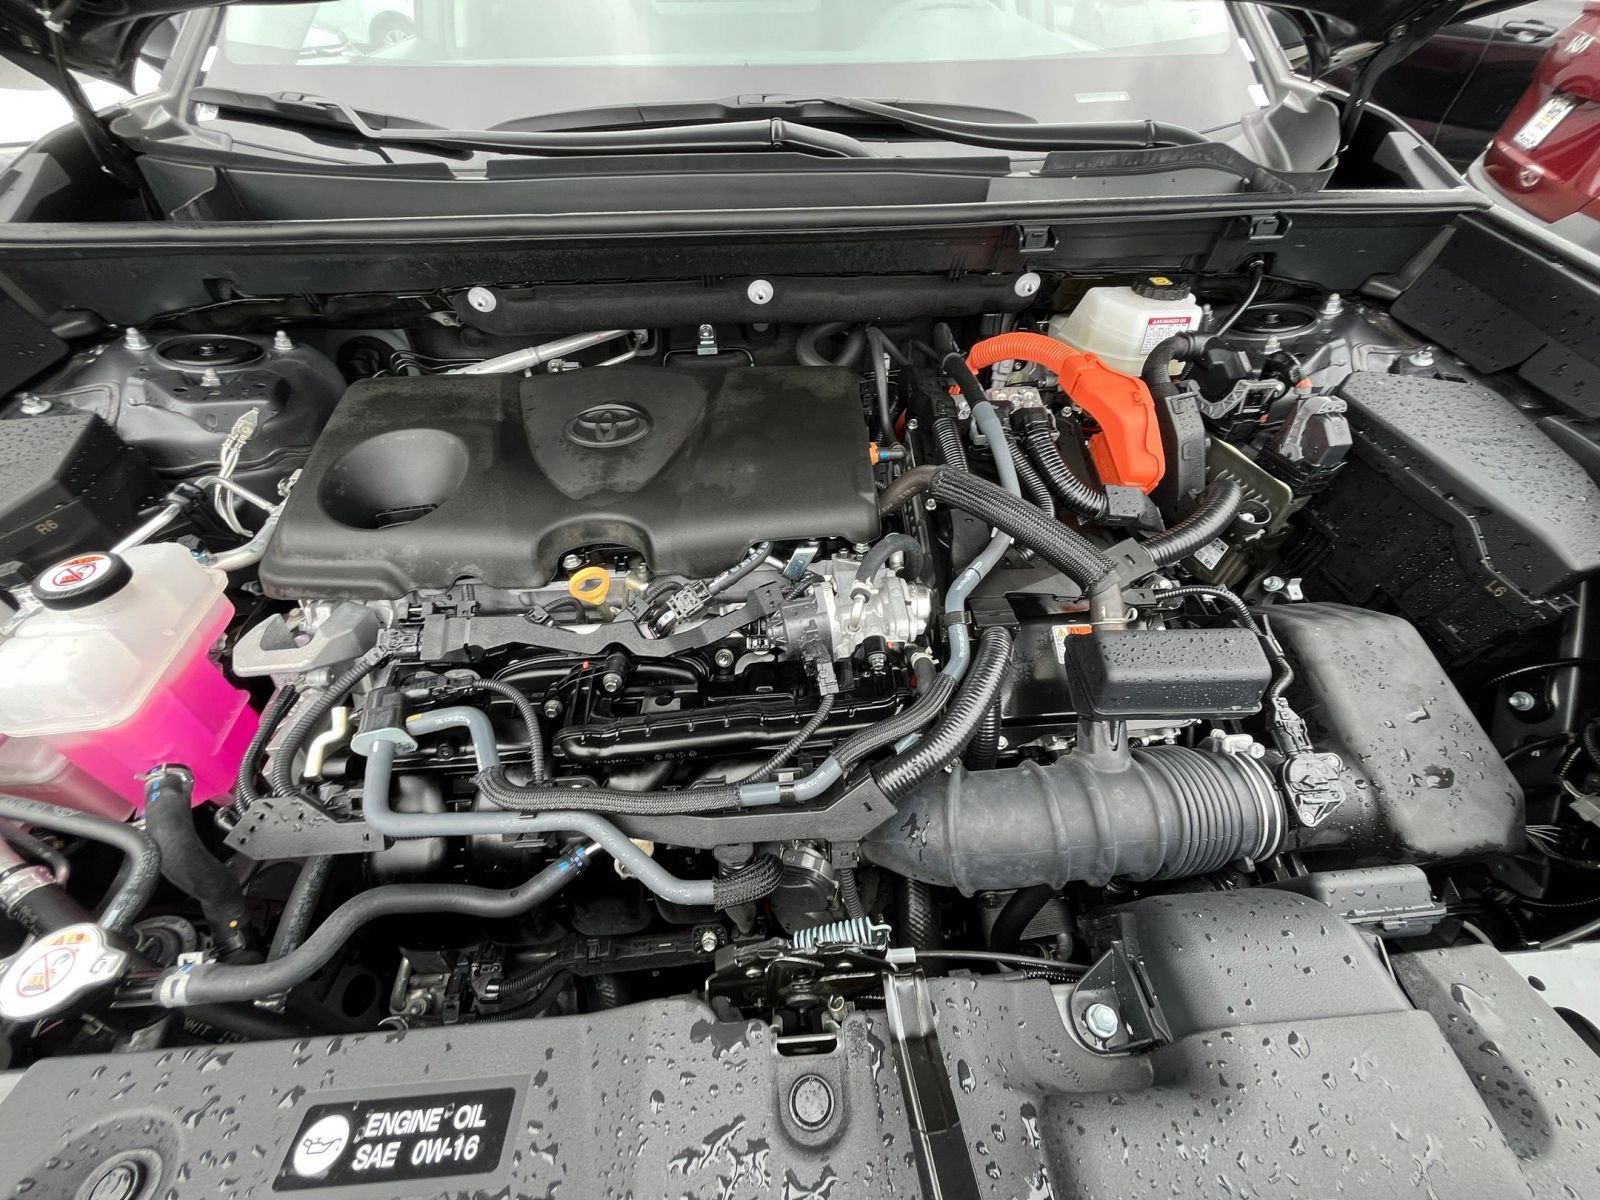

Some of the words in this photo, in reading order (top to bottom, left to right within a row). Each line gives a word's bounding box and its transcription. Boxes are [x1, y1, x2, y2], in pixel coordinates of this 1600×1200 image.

[34, 519, 58, 535] R6
[364, 1107, 444, 1138] ENGINE
[453, 1104, 486, 1130] OIL
[352, 1141, 401, 1171] SAE
[411, 1134, 480, 1165] 0W-16
